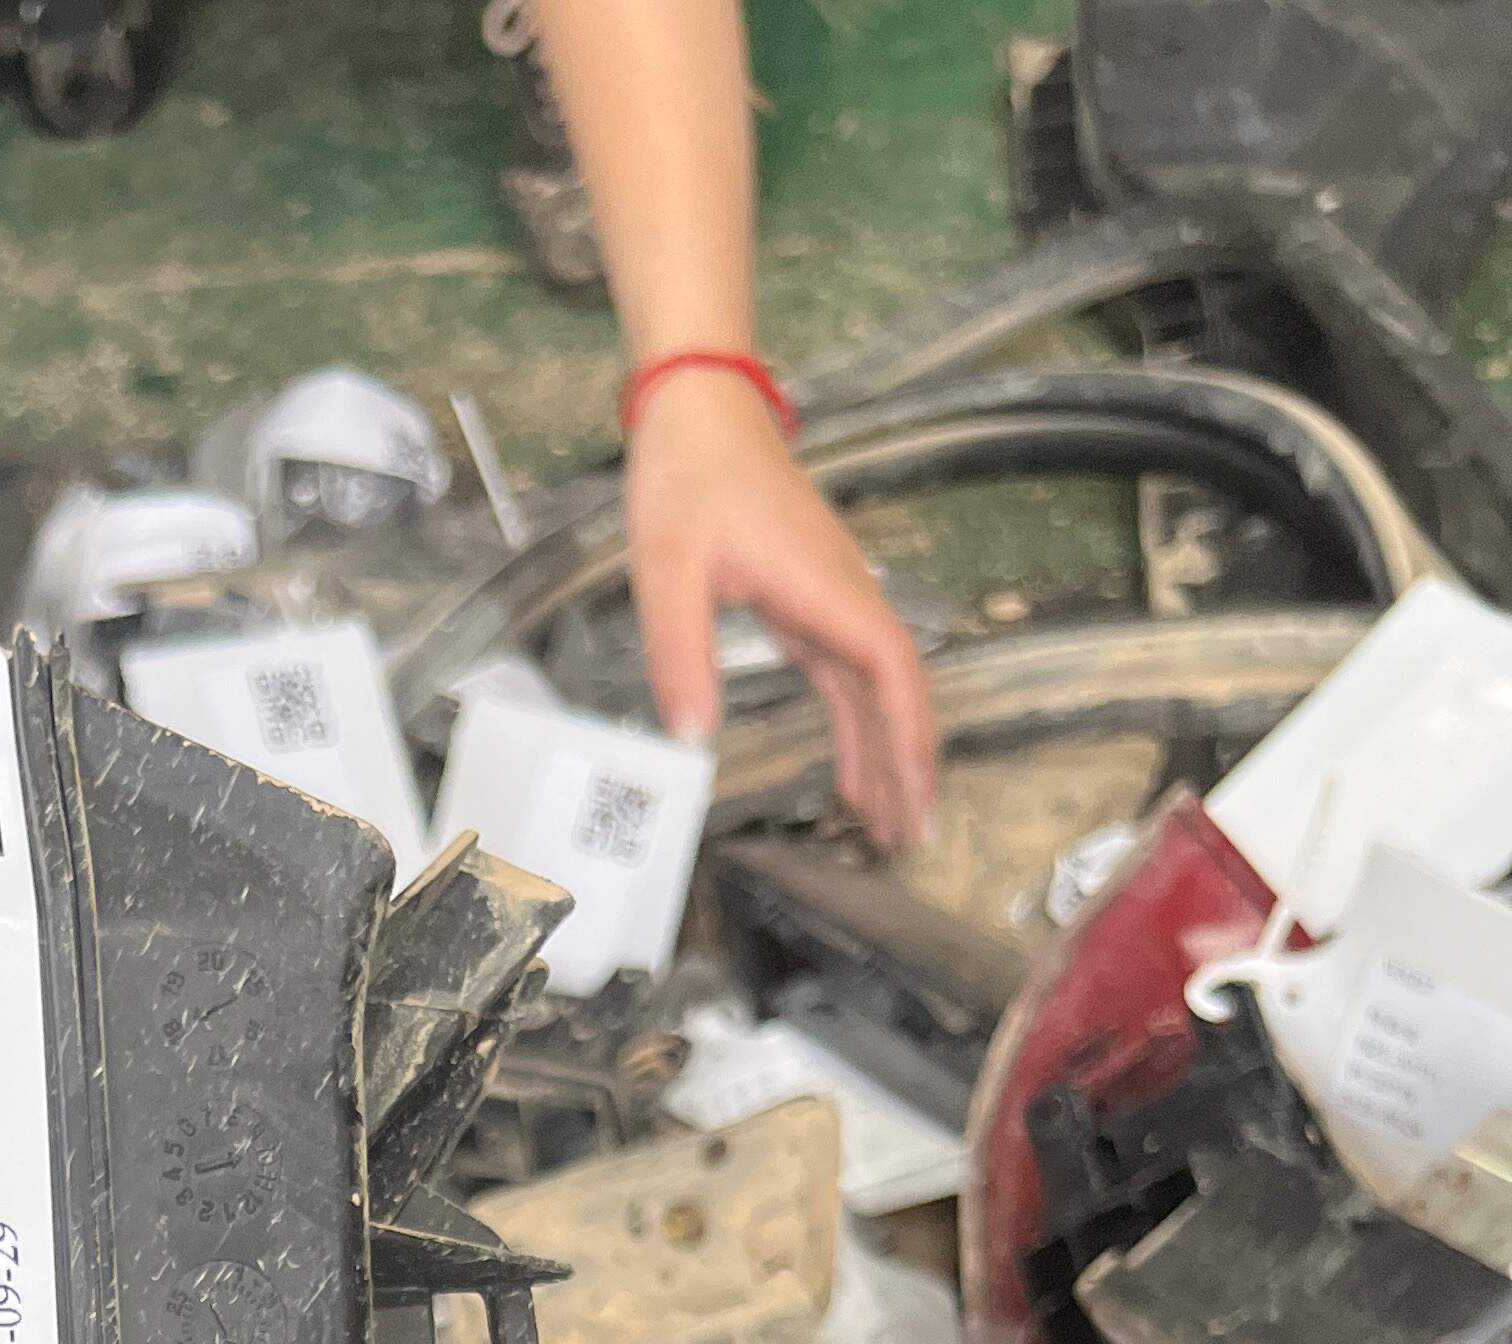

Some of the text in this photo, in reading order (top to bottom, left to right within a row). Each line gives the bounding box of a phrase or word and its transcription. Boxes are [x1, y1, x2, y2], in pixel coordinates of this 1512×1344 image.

[197, 951, 224, 972] 20
[163, 1139, 185, 1158] 5
[198, 1200, 216, 1223] 2
